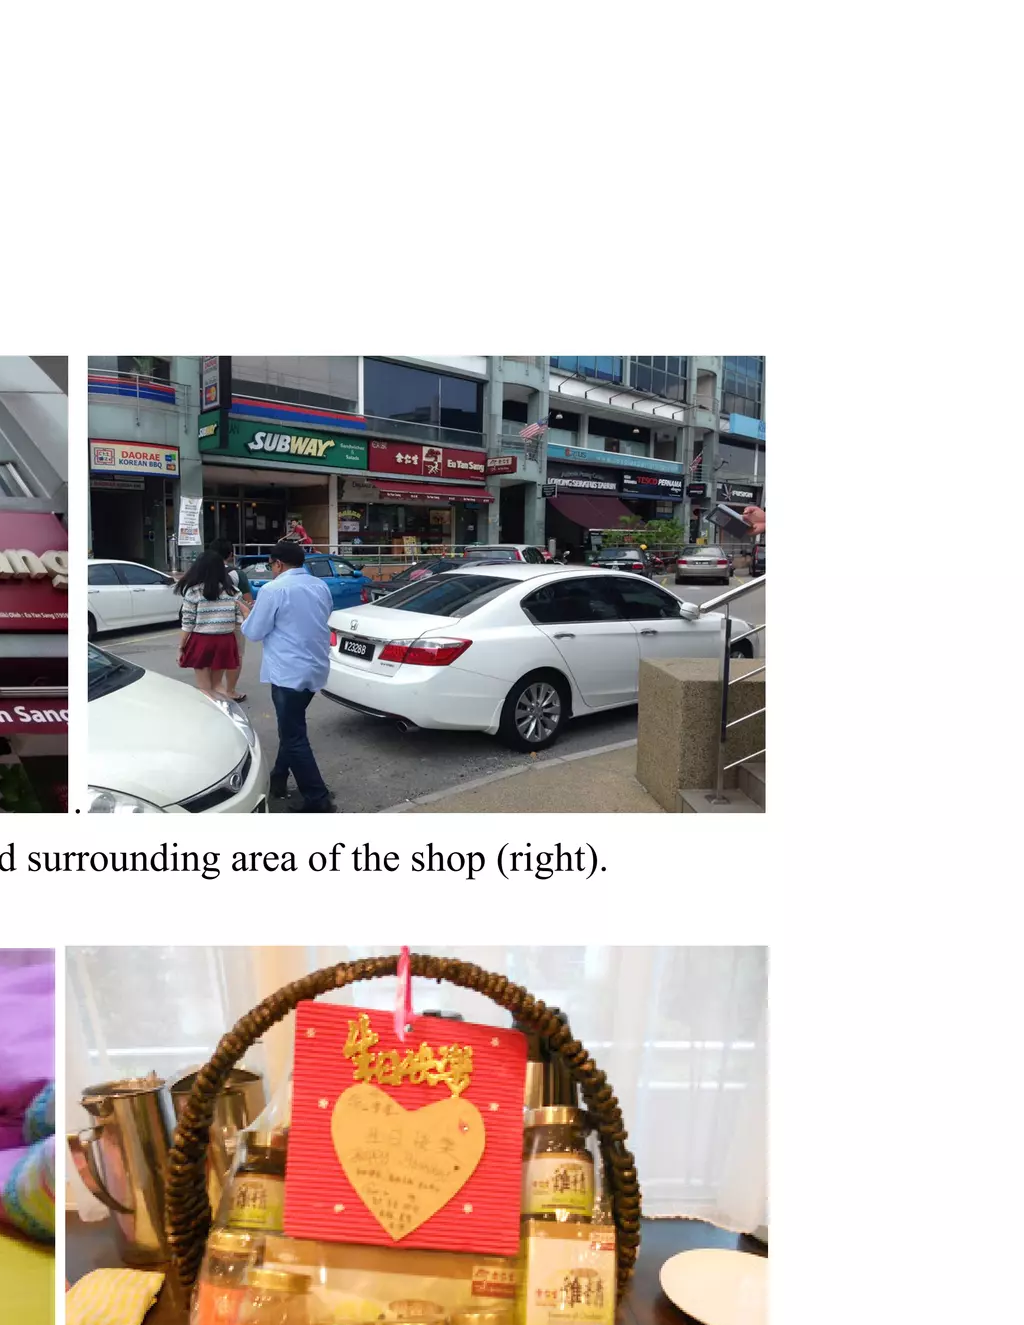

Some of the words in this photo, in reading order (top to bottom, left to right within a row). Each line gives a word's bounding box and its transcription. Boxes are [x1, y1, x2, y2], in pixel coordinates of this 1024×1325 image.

[198, 423, 218, 438] SUBWAY
[247, 431, 336, 457] SUBWAY
[121, 450, 161, 461] DAORAE
[118, 458, 148, 467] KOREAN
[149, 460, 163, 469] BBQ
[447, 459, 457, 468] Eu
[456, 460, 469, 470] Yan
[468, 460, 485, 473] Sang
[29, 843, 220, 879] surrounding
[232, 852, 297, 871] area
[309, 843, 345, 871] of
[352, 843, 399, 871] the
[412, 843, 485, 879] shop
[498, 843, 606, 879] (right).
